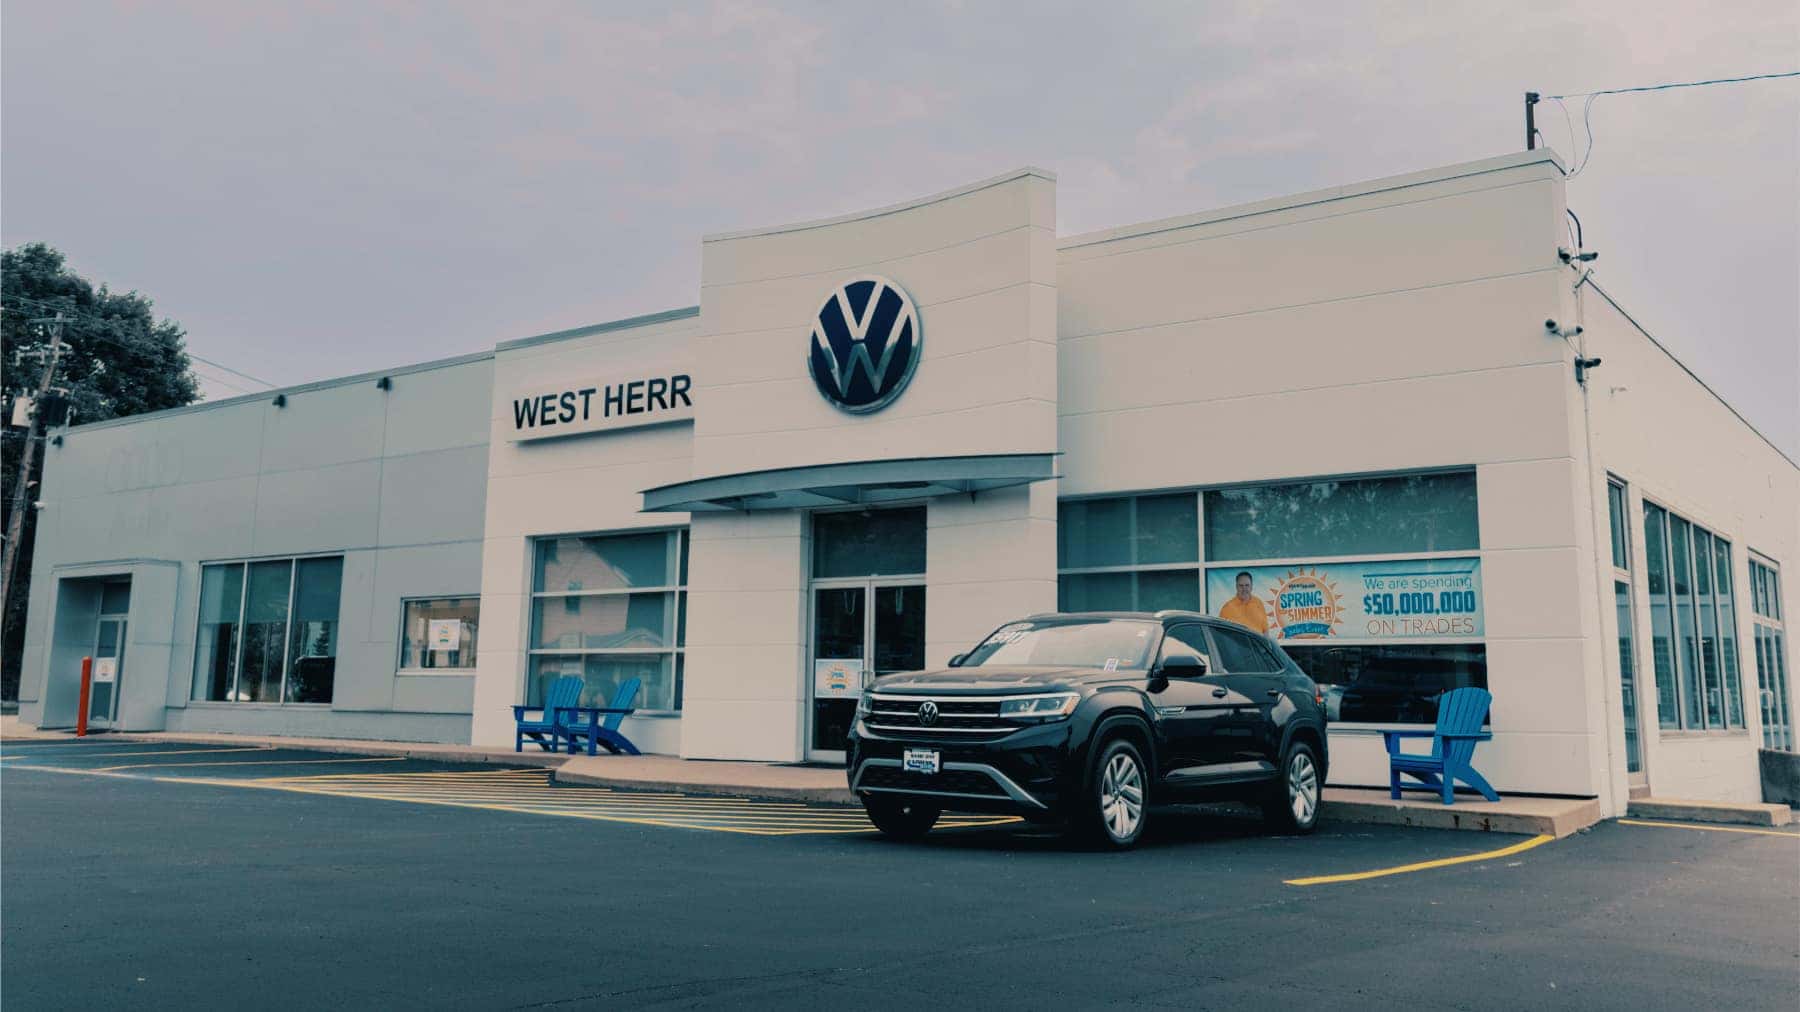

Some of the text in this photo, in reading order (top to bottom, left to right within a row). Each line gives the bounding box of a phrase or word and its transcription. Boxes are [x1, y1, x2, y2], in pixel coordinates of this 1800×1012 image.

[513, 373, 693, 430] WEST HERR
[1364, 576, 1472, 591] We are spending
[1280, 590, 1322, 609] SPRING
[1363, 591, 1476, 616] $50,000,000
[1288, 606, 1333, 622] SUMMER
[1366, 617, 1474, 635] ON TRADES
